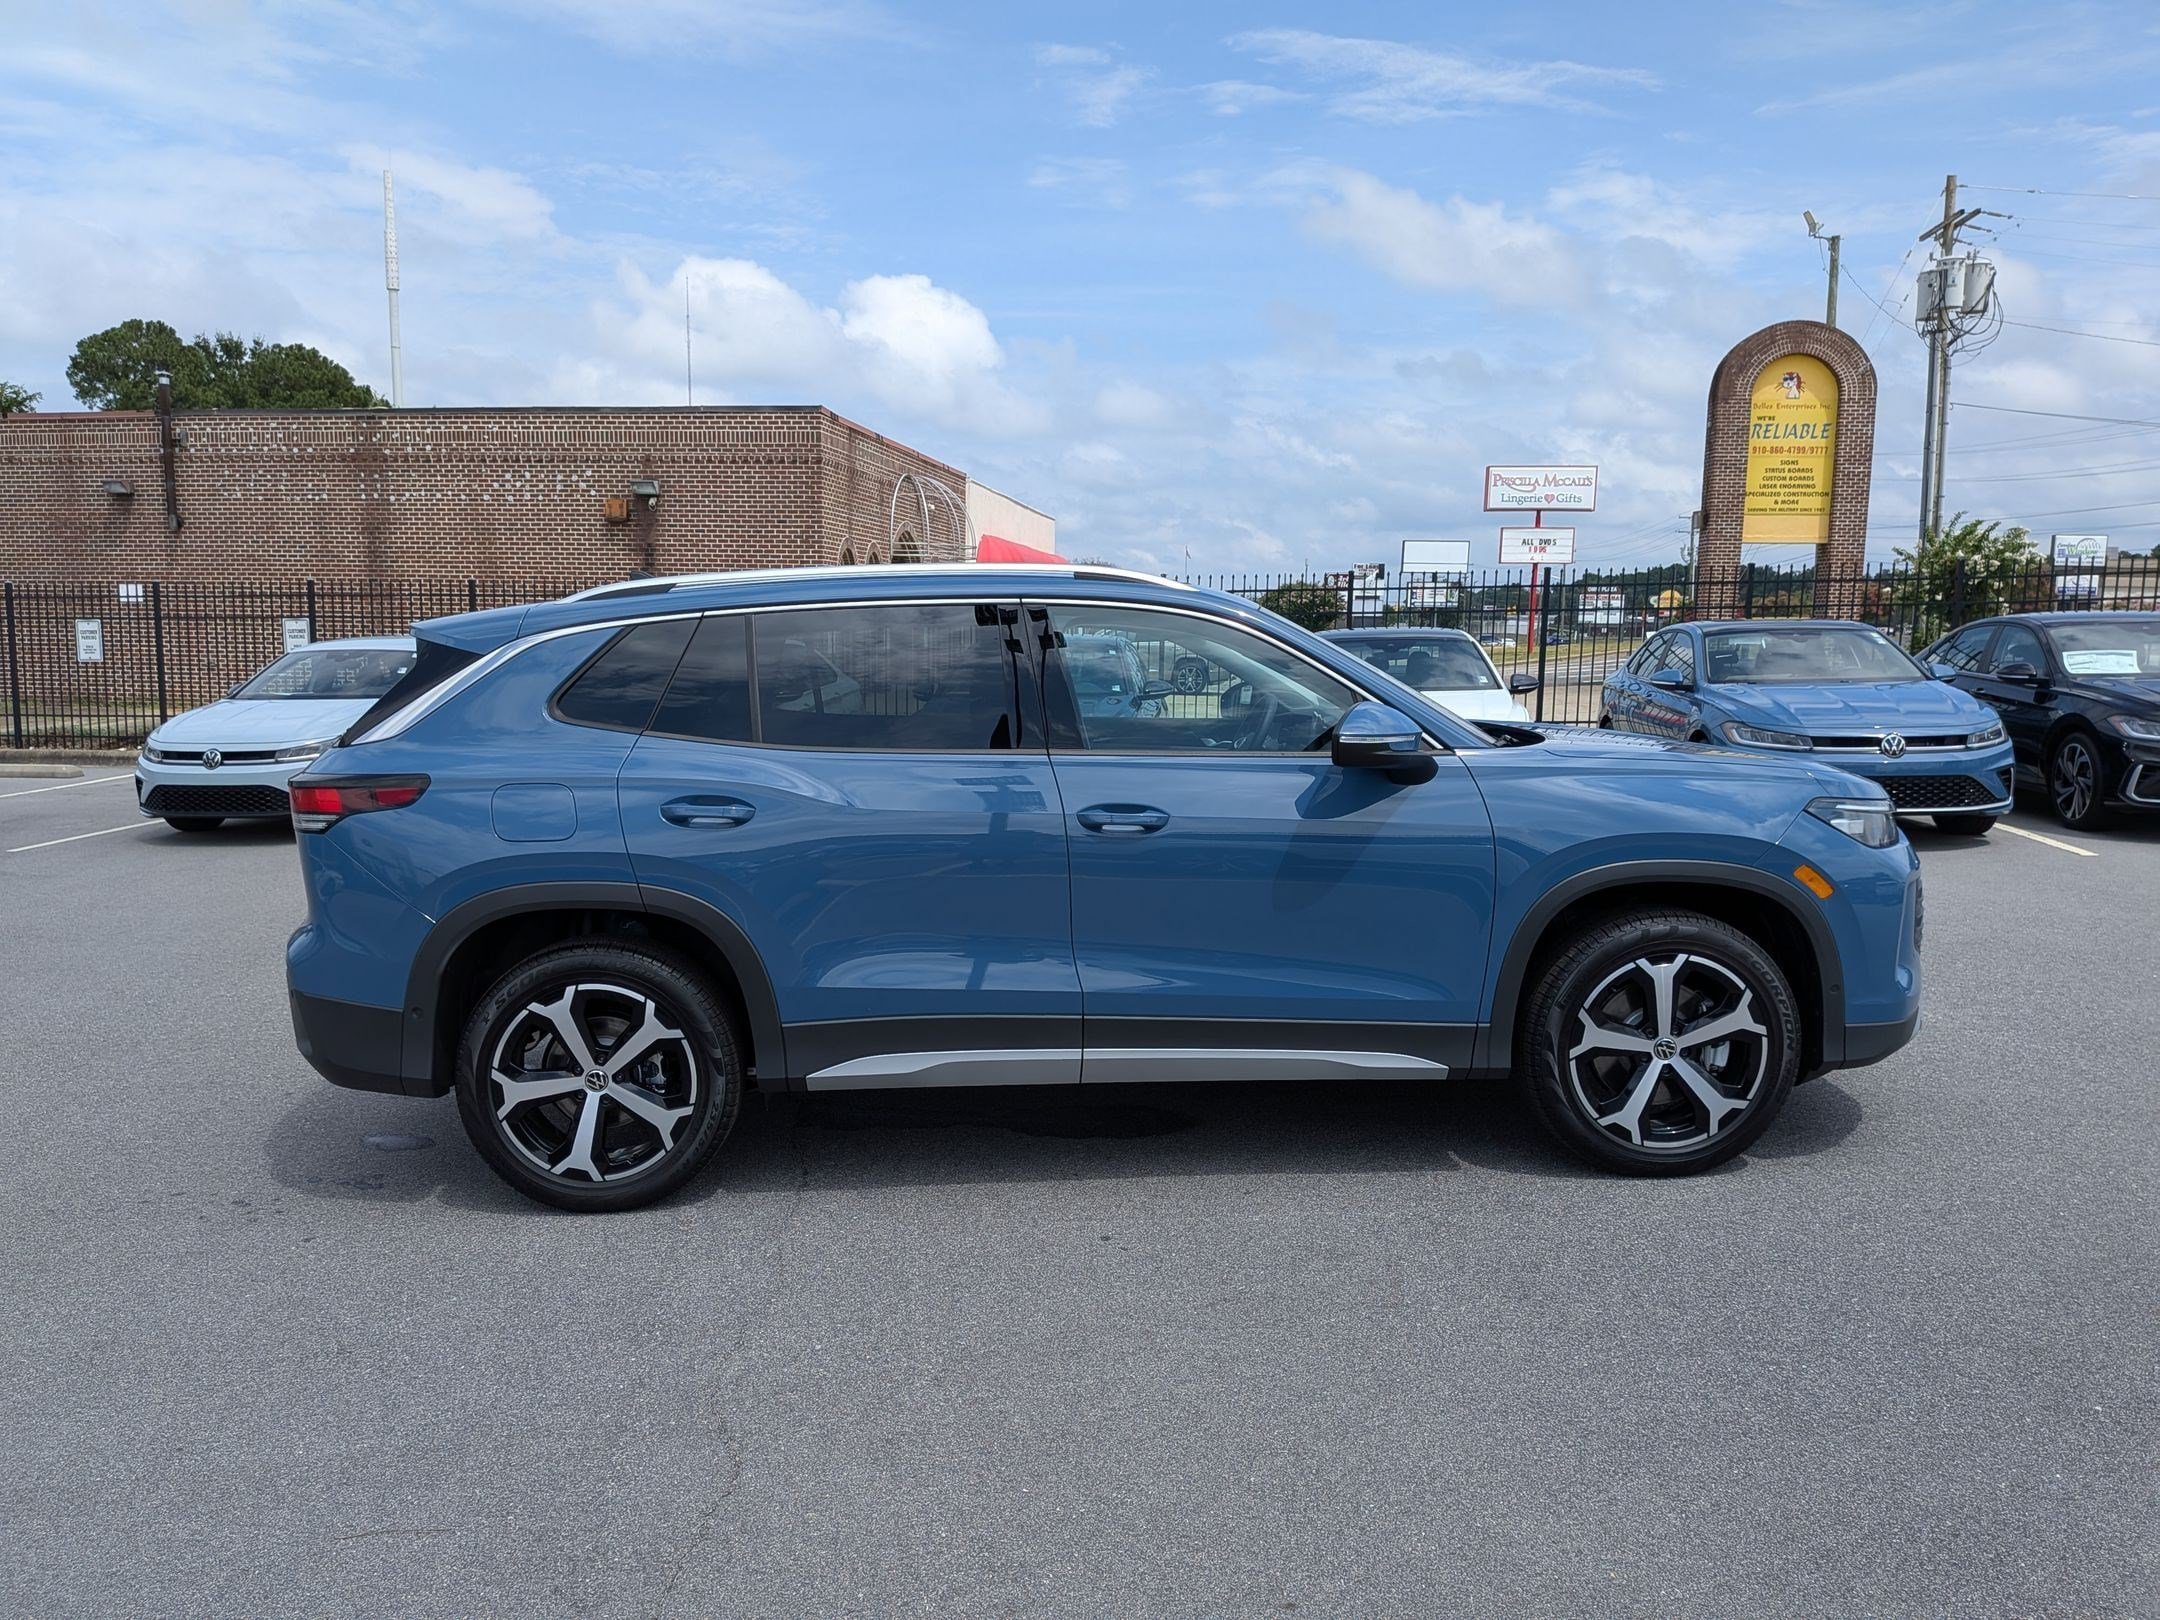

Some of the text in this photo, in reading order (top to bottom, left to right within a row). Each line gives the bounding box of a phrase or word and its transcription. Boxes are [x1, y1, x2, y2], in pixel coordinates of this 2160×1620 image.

[1751, 423, 1832, 439] RELIABLE
[1492, 473, 1540, 492] PRISCILLA
[1501, 493, 1582, 505] Lingerie Gifts
[1521, 538, 1534, 546] ALL
